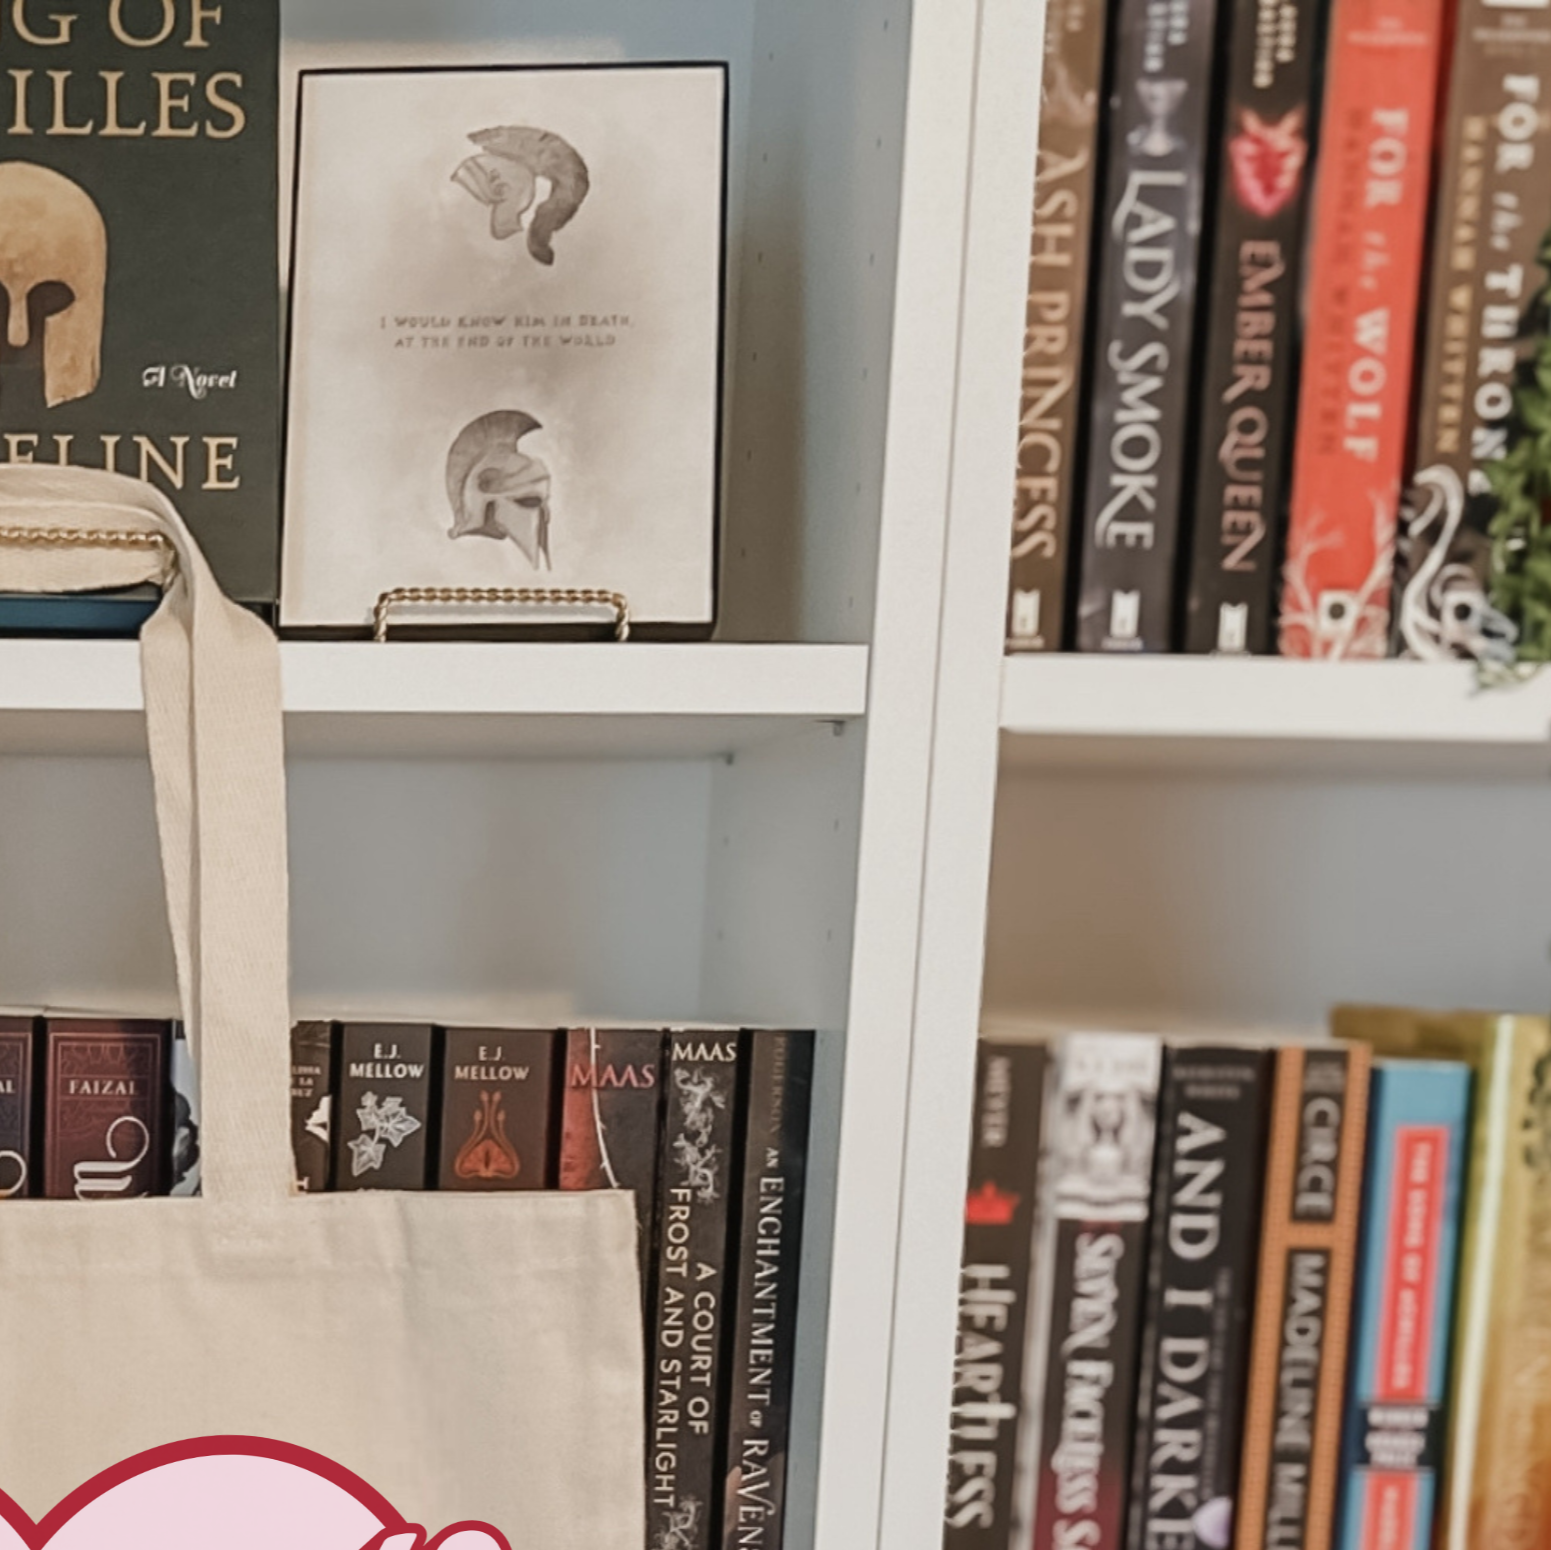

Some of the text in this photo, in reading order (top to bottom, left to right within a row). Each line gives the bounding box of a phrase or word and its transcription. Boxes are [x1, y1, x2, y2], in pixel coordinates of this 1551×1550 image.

[108, 0, 222, 48] OF
[1363, 107, 1410, 208] FOR
[1494, 73, 1541, 173] FOR
[1111, 170, 1187, 331] LADY
[394, 315, 451, 329] WOULD
[457, 315, 507, 329] KNOW
[394, 335, 415, 348] AT
[457, 334, 490, 348] END
[558, 334, 617, 348] WORLD
[1010, 145, 1090, 558] ASH PRINCESS
[170, 365, 238, 400] Novel
[1218, 240, 1286, 572] EMBER QUEEN
[1343, 306, 1392, 462] WOLF
[1095, 338, 1170, 550] SMOKE
[69, 1079, 139, 1096] FAIZAL
[350, 1062, 424, 1079] MELLOW
[454, 1065, 530, 1081] MELLOW
[570, 1064, 656, 1089] MAAS
[671, 1042, 738, 1062] MAAS
[1168, 1110, 1227, 1261] AND
[1294, 1097, 1342, 1217] CIRCE
[746, 1176, 785, 1406] ENCHANTMENT
[1164, 1288, 1214, 1308] I
[653, 1188, 692, 1508] FROST AND STARLIGHT
[686, 1262, 718, 1435] A COURT OF
[944, 1263, 1017, 1529] HEARTLESS
[1274, 1253, 1325, 1450] MADELINE
